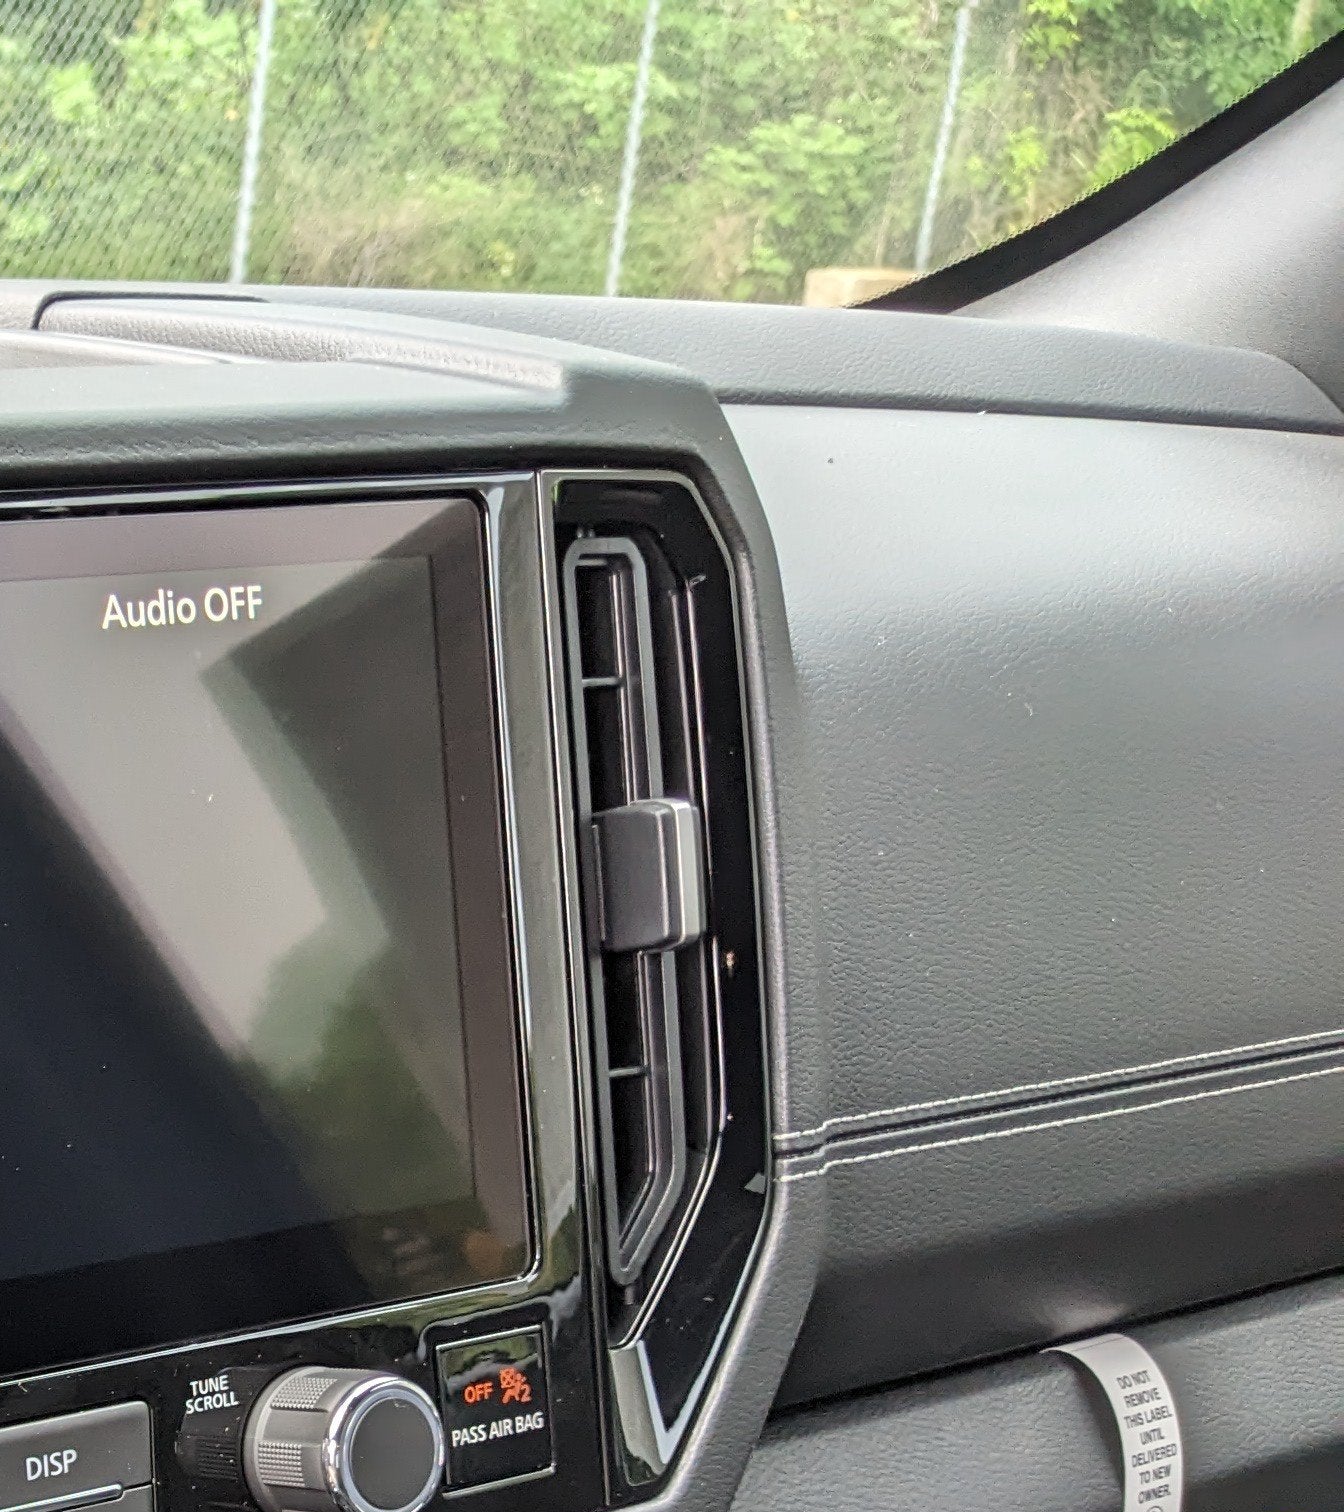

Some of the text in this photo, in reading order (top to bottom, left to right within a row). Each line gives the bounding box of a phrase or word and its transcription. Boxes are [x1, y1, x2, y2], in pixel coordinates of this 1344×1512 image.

[102, 584, 264, 630] Audio OFF
[190, 1374, 230, 1395] TUNE
[1117, 1370, 1151, 1389] DO NOT
[464, 1381, 493, 1403] OFF
[1123, 1388, 1161, 1408] REMOVE
[185, 1391, 239, 1416] SCROLL
[1124, 1406, 1173, 1429] THIS LABEL
[452, 1411, 545, 1447] PASS AIR BAG
[1139, 1428, 1165, 1445] UNTIL
[25, 1449, 78, 1481] DISP
[1131, 1443, 1178, 1468] DELIVERED
[1139, 1464, 1172, 1484] TO NEW
